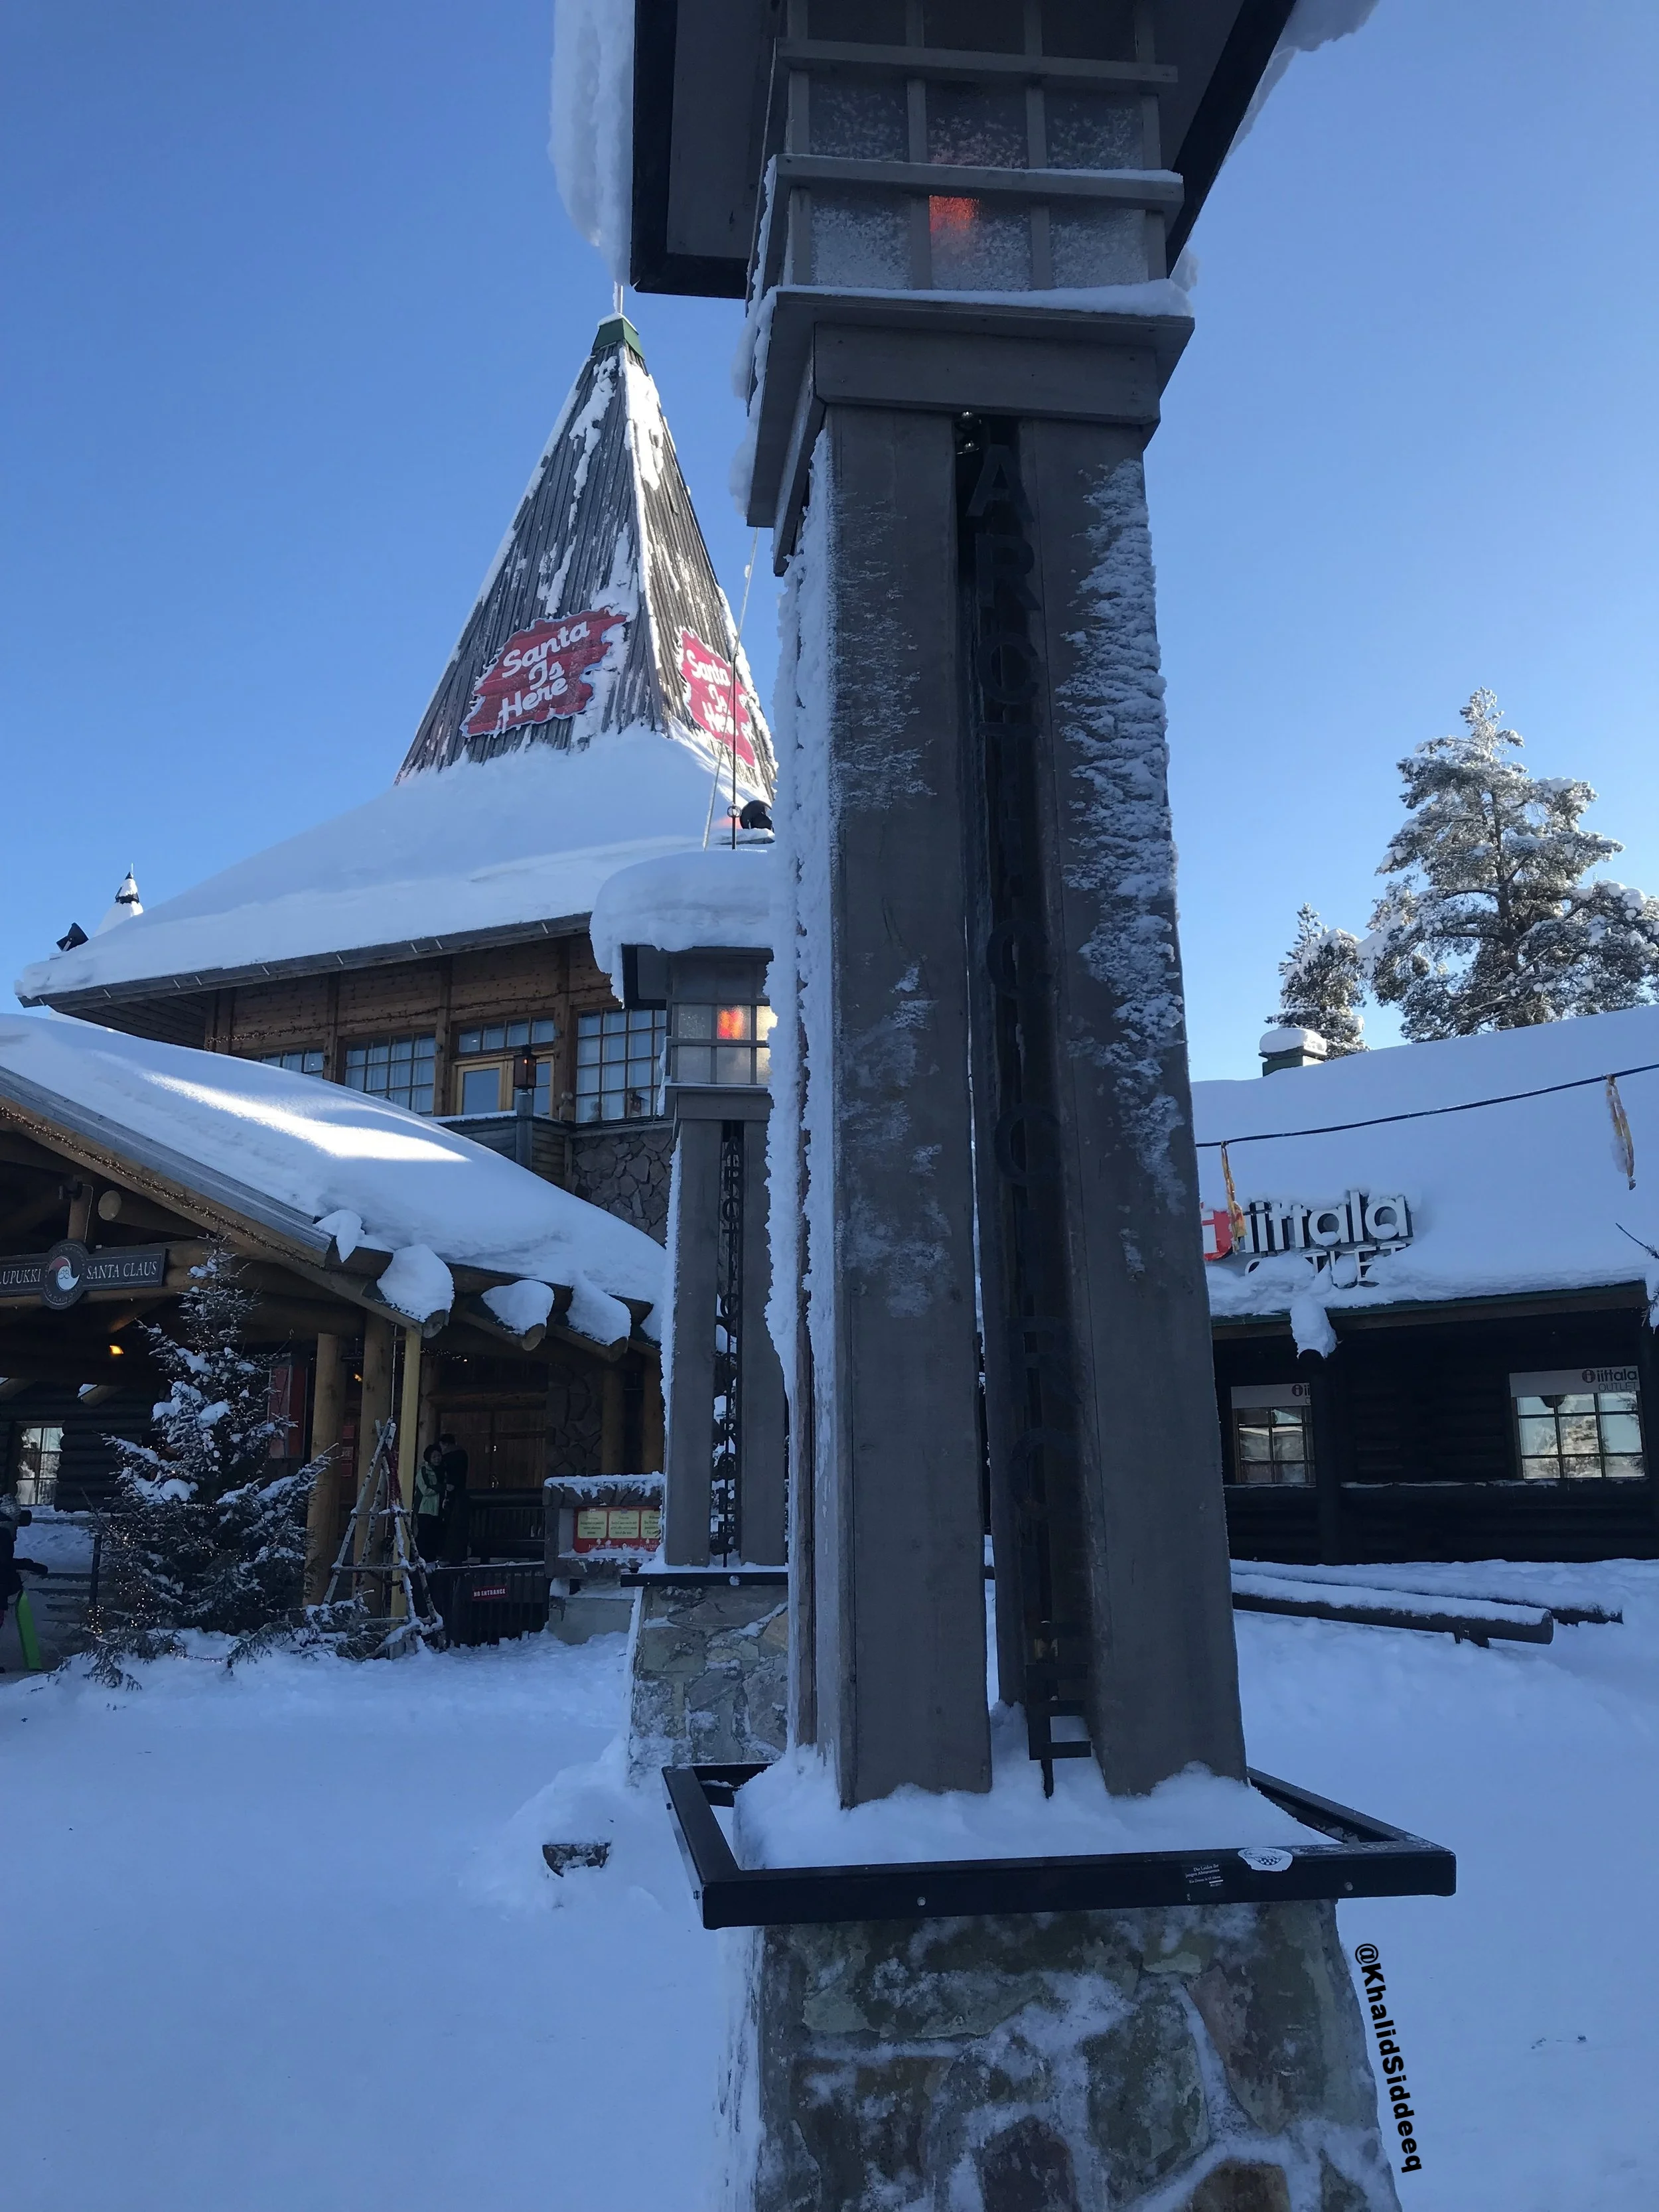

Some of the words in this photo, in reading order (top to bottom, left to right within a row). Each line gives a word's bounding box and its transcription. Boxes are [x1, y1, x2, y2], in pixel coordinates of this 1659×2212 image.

[502, 621, 591, 678] Santa
[528, 661, 565, 690] Is
[685, 648, 731, 687] Santa
[498, 676, 568, 734] Here
[1244, 1189, 1408, 1254] iittala
[86, 1263, 119, 1280] SANTA
[123, 1260, 157, 1278] CLAUS
[1597, 1368, 1638, 1382] iittala
[1599, 1381, 1638, 1392] OUTLET
